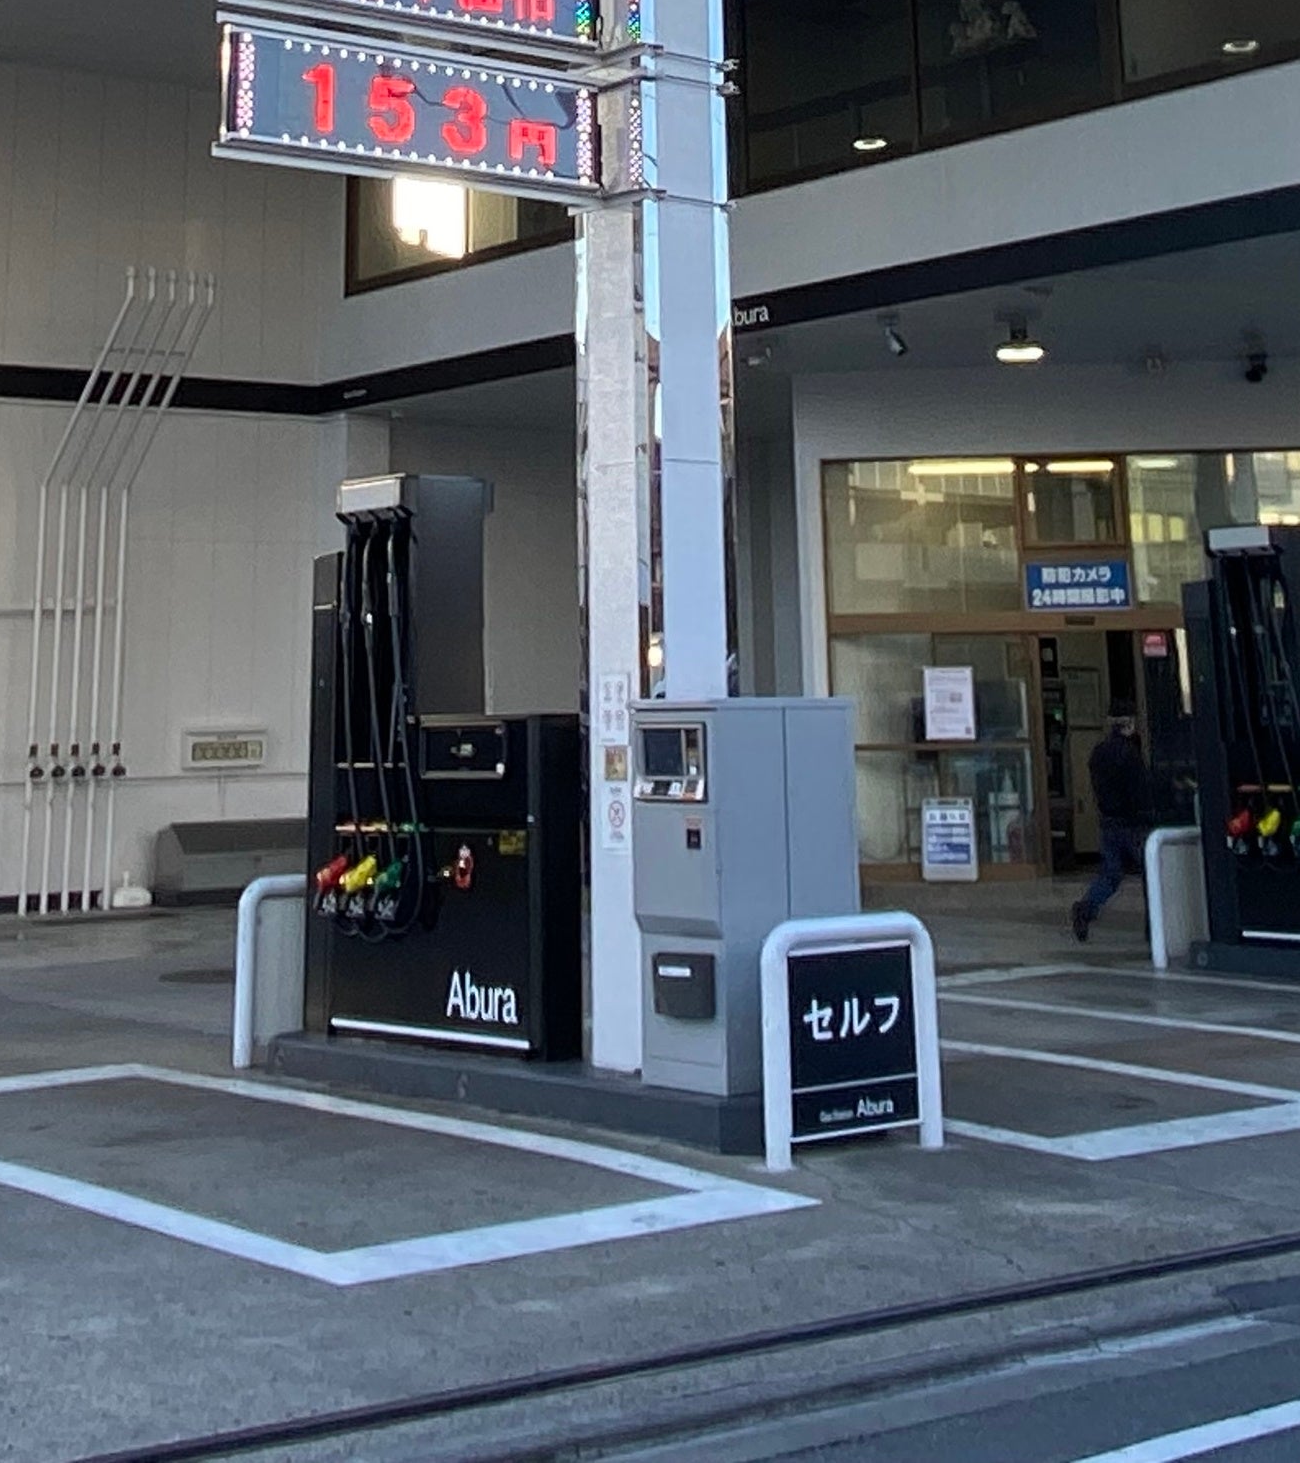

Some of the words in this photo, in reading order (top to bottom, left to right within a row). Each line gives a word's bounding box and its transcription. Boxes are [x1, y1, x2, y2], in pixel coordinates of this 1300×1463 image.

[731, 305, 770, 326] bura
[446, 968, 519, 1025] Abura
[803, 996, 899, 1040] セルフ
[857, 1097, 894, 1118] Abura
